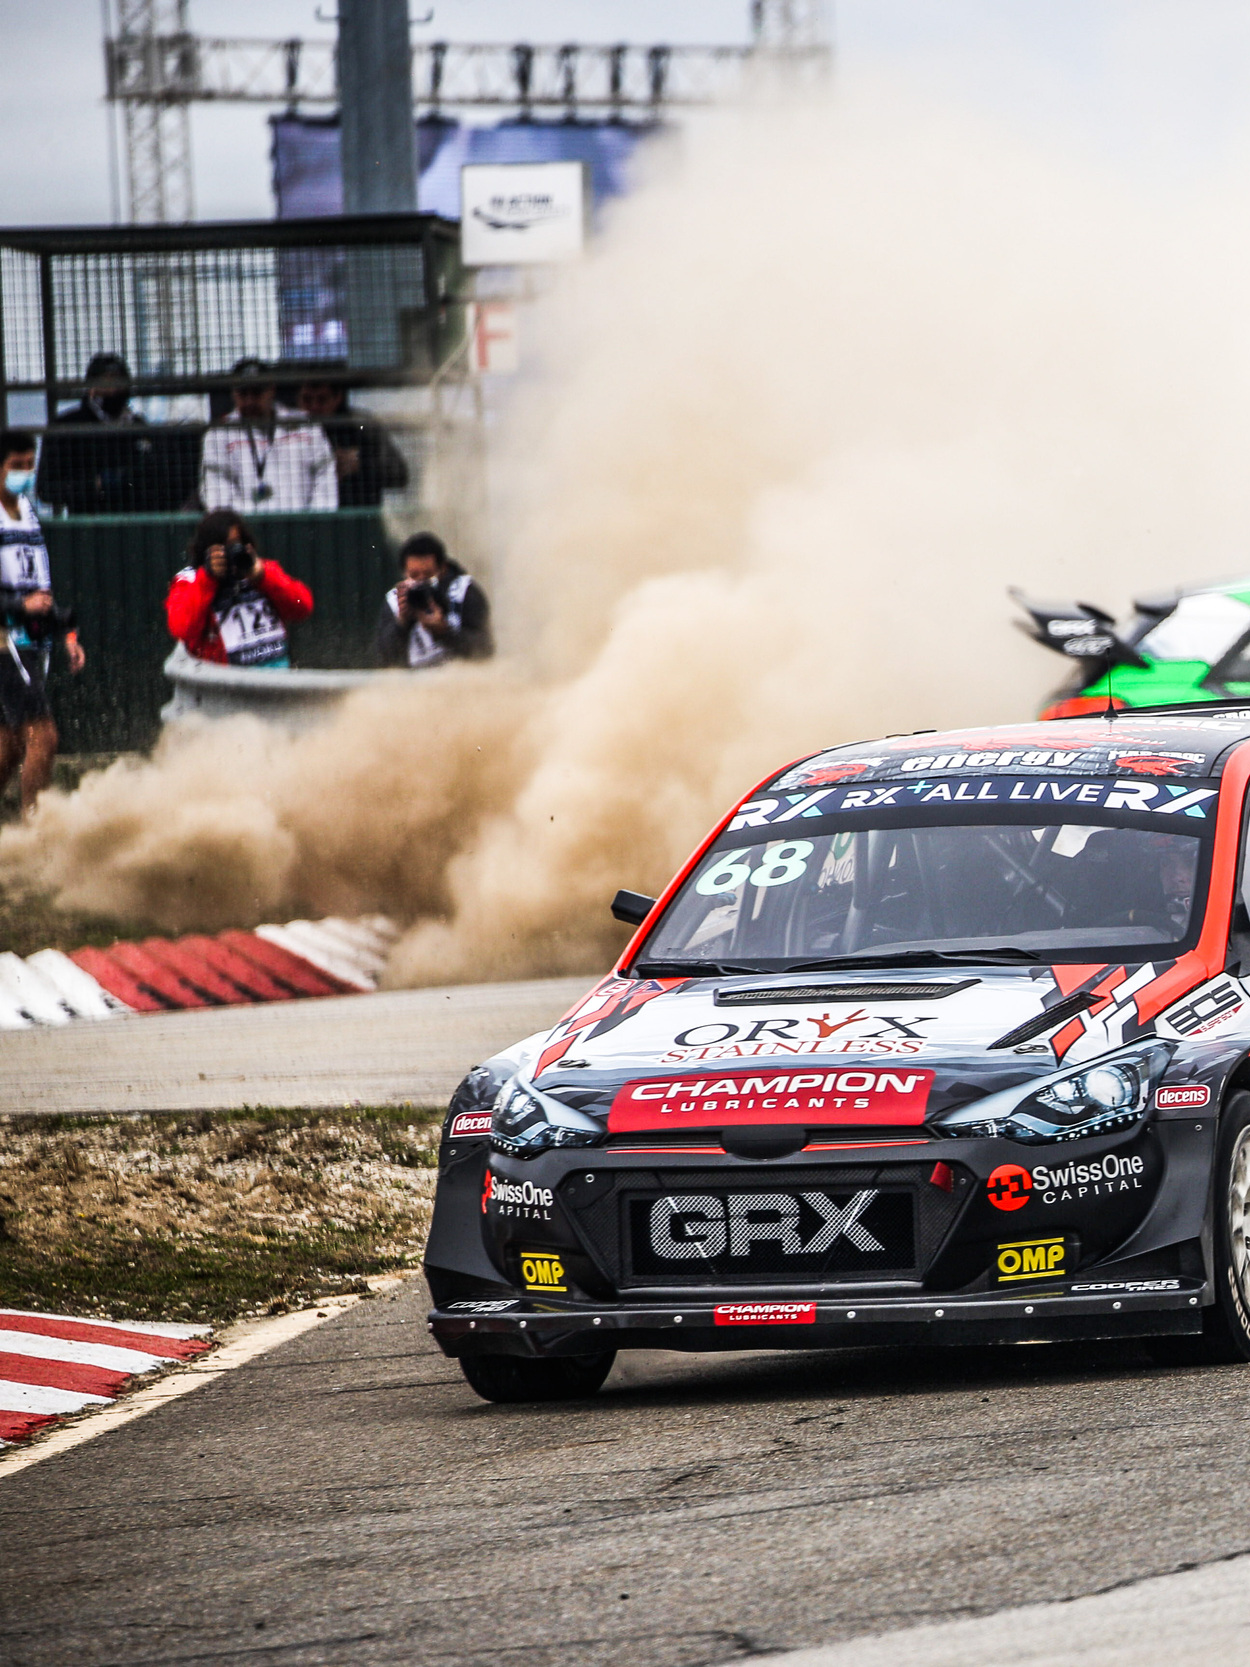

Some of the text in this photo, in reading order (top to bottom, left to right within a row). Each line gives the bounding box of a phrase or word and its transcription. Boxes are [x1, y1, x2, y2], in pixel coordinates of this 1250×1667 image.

[901, 751, 1084, 772] energy
[727, 788, 837, 832] RX
[1009, 782, 1104, 802] LIVE
[1103, 780, 1219, 818] RX
[695, 840, 815, 896] 68
[674, 1009, 938, 1046] ORYX
[661, 1040, 923, 1063] STAINLESS
[631, 1073, 920, 1100] CHAMPION
[1159, 1088, 1206, 1105] decens
[661, 1098, 869, 1113] LUBRICANTS
[456, 1115, 492, 1131] decen
[1032, 1154, 1144, 1190] SwissOne
[491, 1176, 553, 1206] SwissOne
[1042, 1178, 1143, 1204] CAPITAL
[499, 1205, 552, 1220] APITAL
[650, 1189, 886, 1259] GRX
[522, 1259, 565, 1285] OMP
[998, 1245, 1065, 1274] OMP
[1071, 1280, 1180, 1291] COOPER
[716, 1303, 813, 1314] CHAMPION
[729, 1313, 798, 1321] LUBRICANTS
